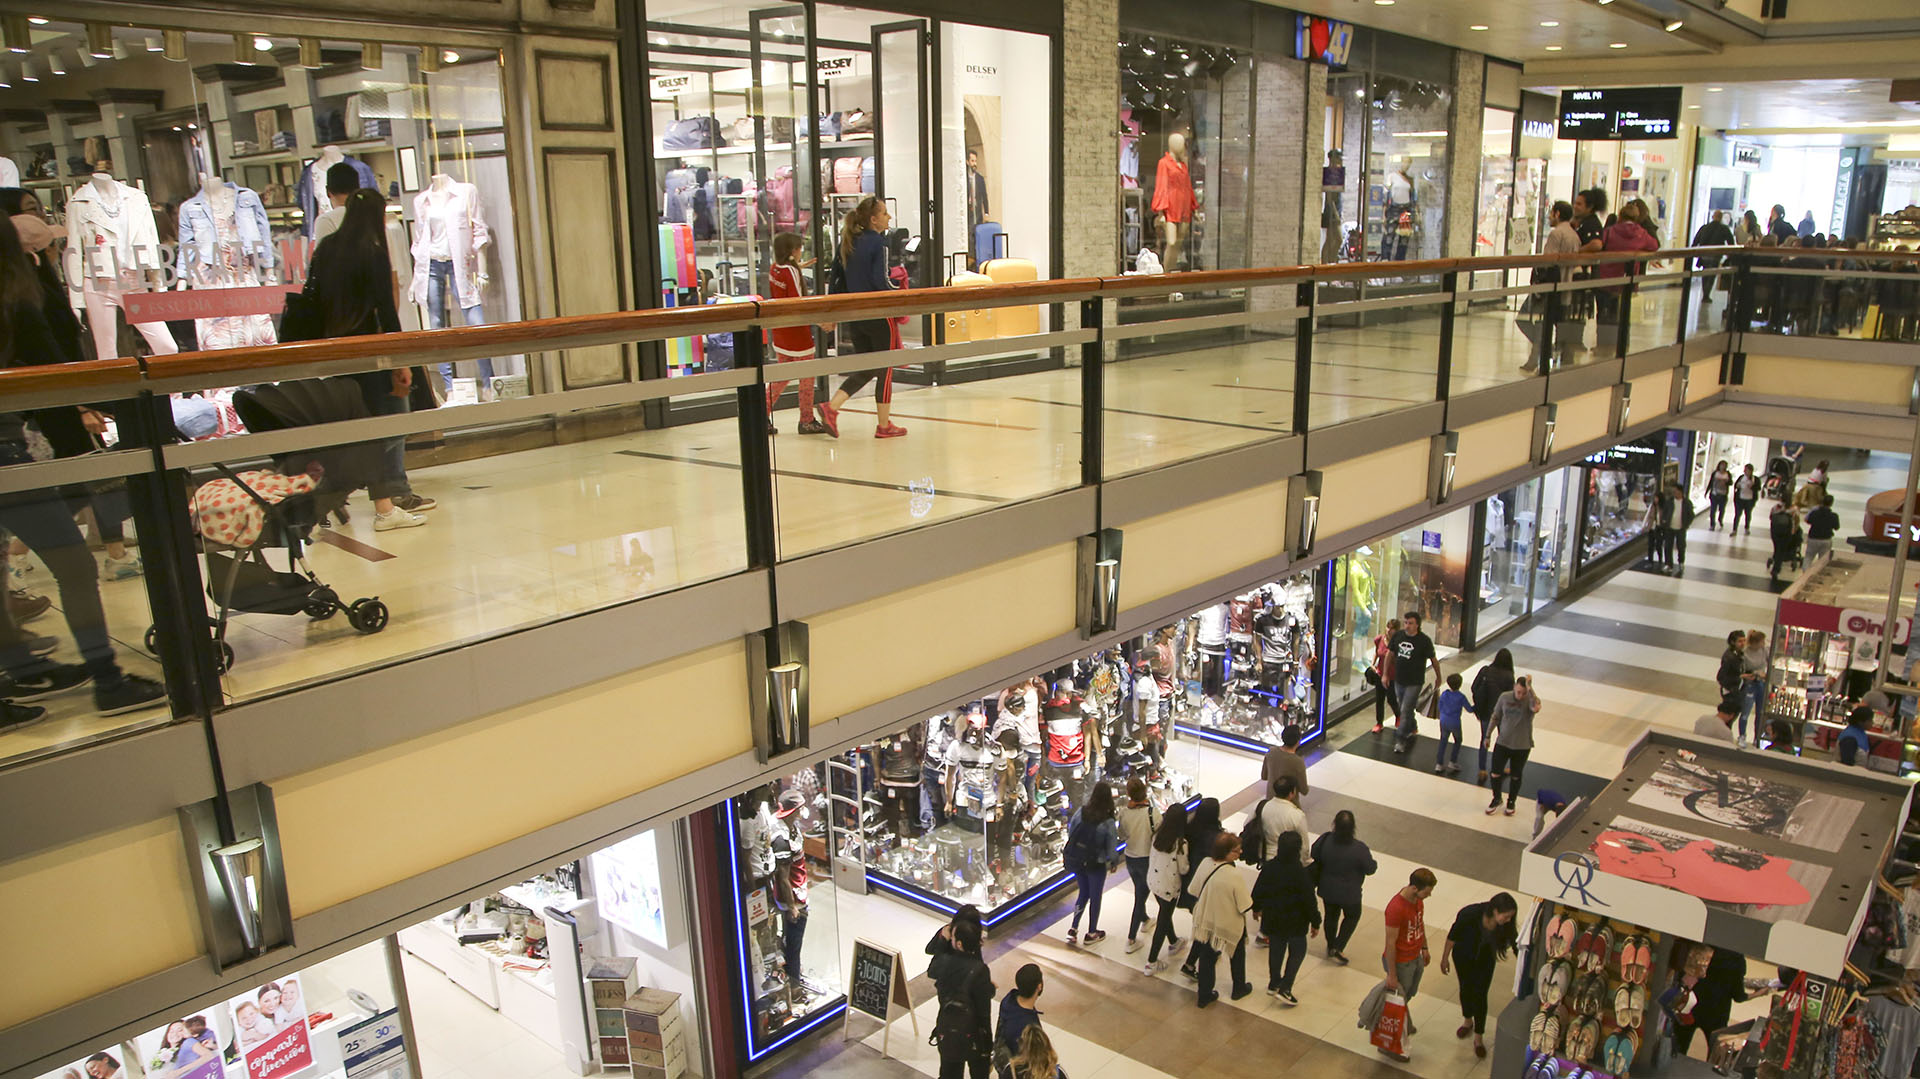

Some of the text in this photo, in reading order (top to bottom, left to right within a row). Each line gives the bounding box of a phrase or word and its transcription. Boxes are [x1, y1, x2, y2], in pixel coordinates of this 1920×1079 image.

[1328, 22, 1354, 65] 47
[817, 58, 852, 70] DELSEY
[966, 65, 998, 75] DELSEY
[658, 76, 689, 87] DELSEY
[1522, 119, 1554, 139] LAZARO
[62, 240, 270, 293] CELEBRATE
